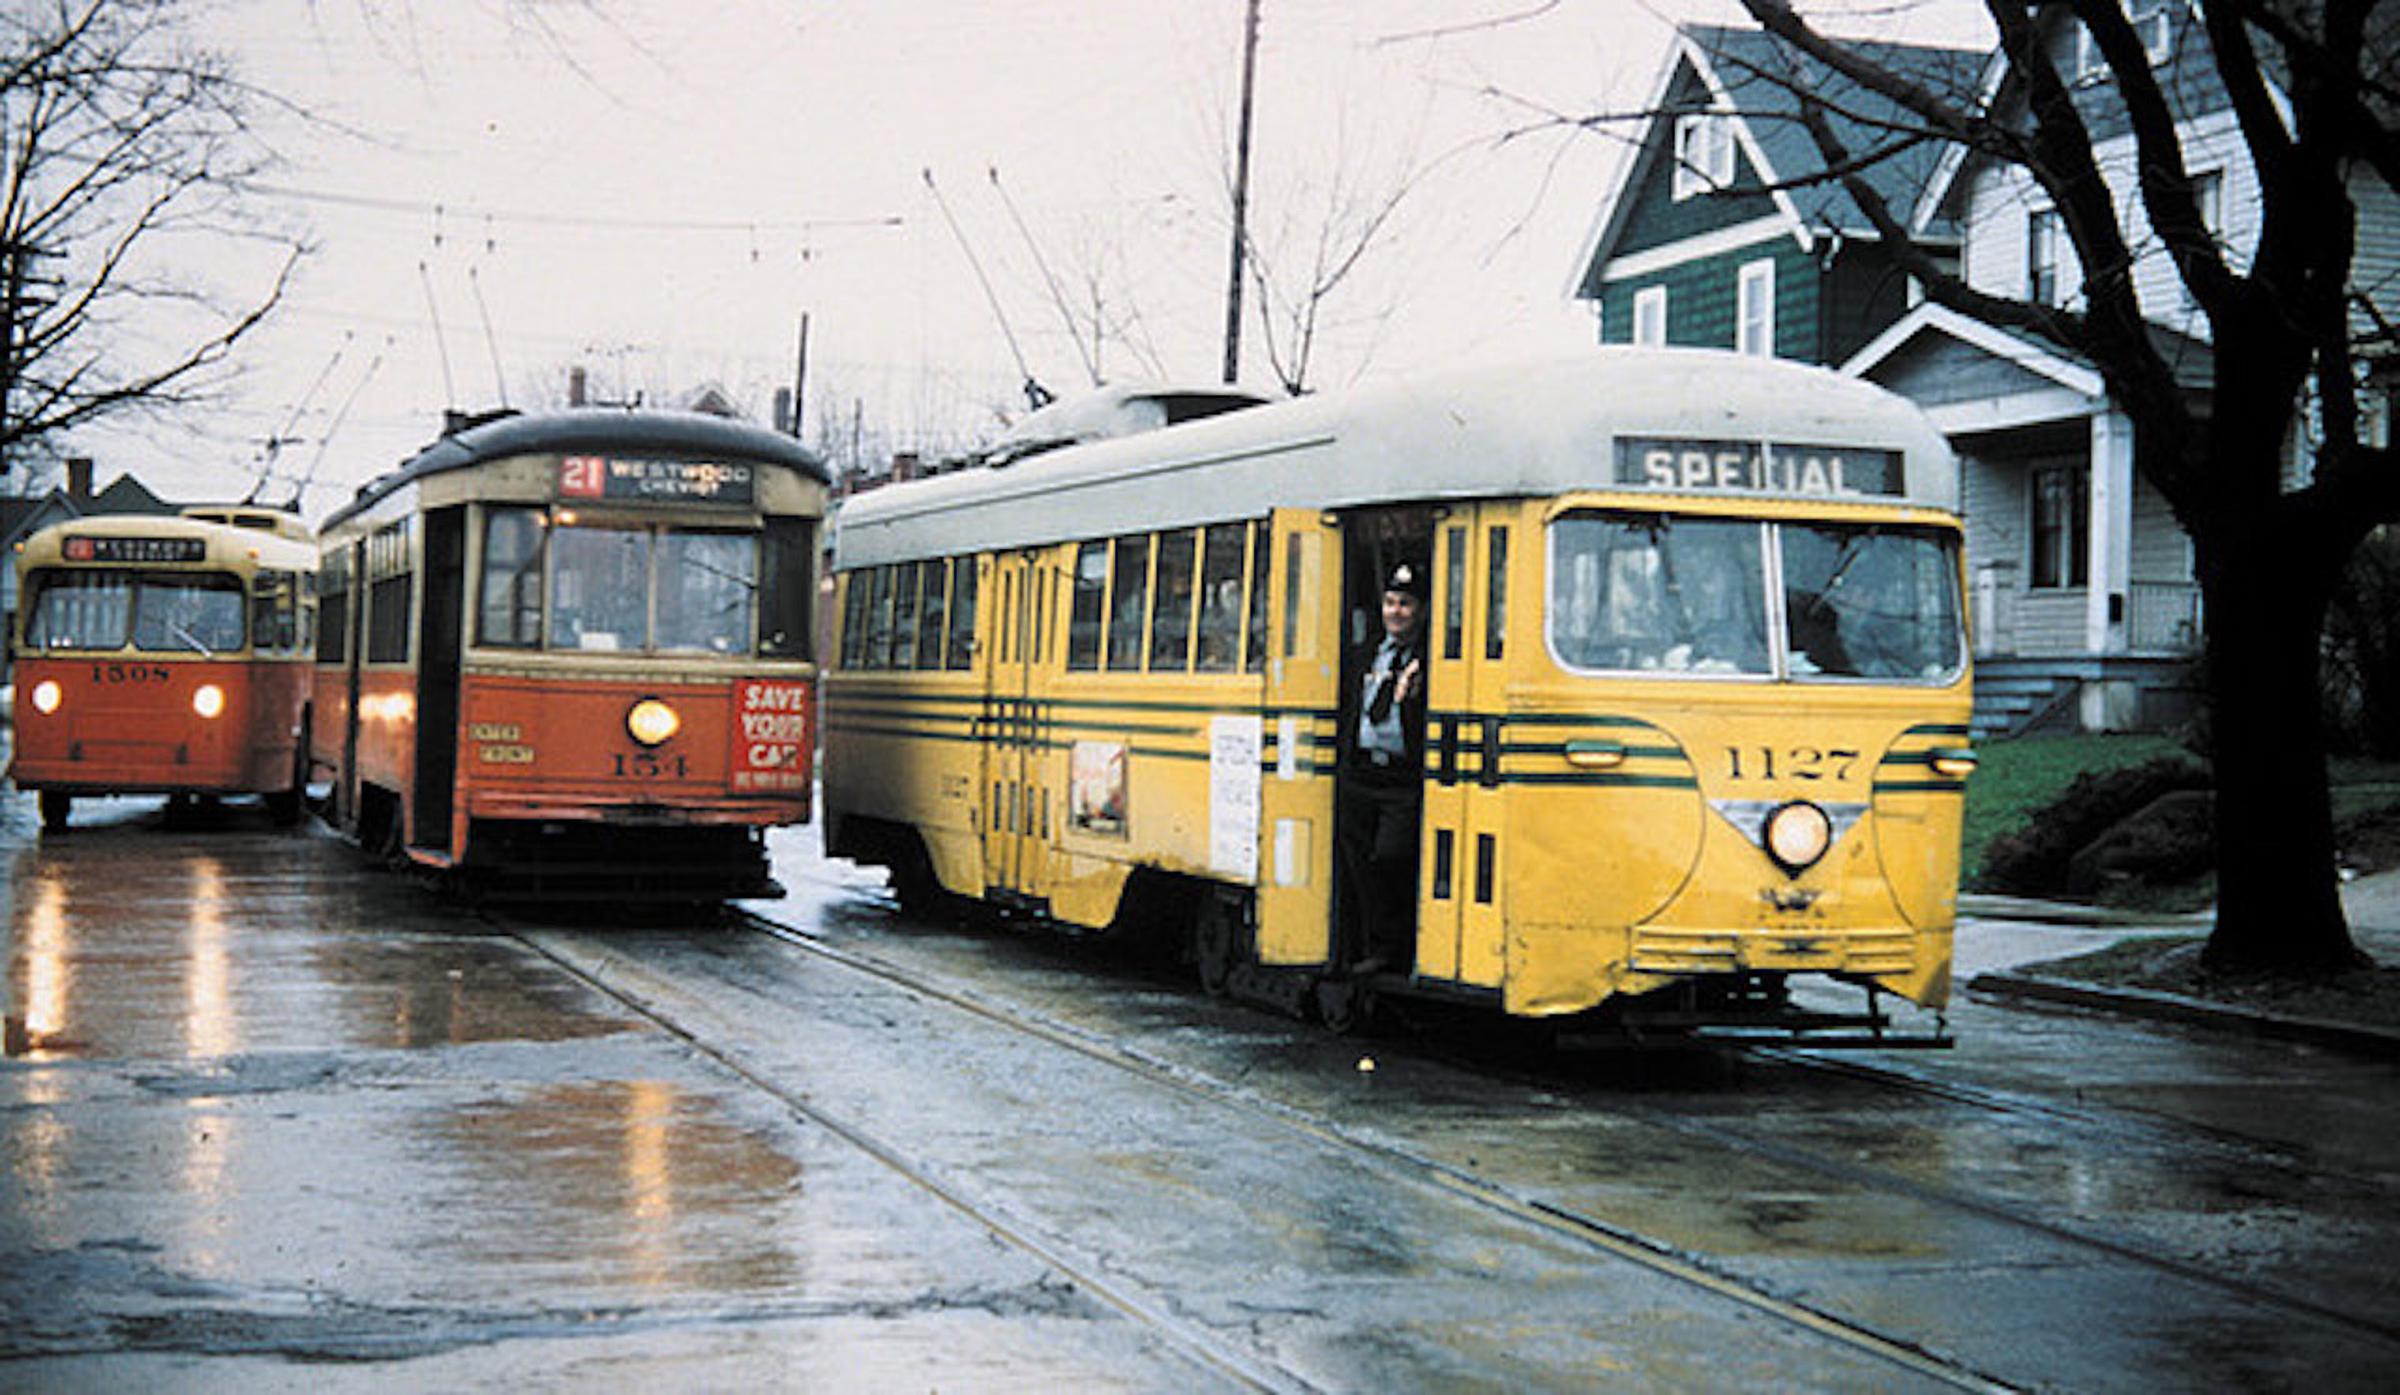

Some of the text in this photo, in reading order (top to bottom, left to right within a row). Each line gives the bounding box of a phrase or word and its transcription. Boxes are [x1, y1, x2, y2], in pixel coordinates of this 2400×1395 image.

[562, 457, 599, 488] 21
[93, 665, 169, 684] 1508
[745, 684, 804, 710] SAVE
[741, 712, 804, 739] YOUR
[748, 744, 799, 769] CAR
[1726, 746, 1861, 781] 1127
